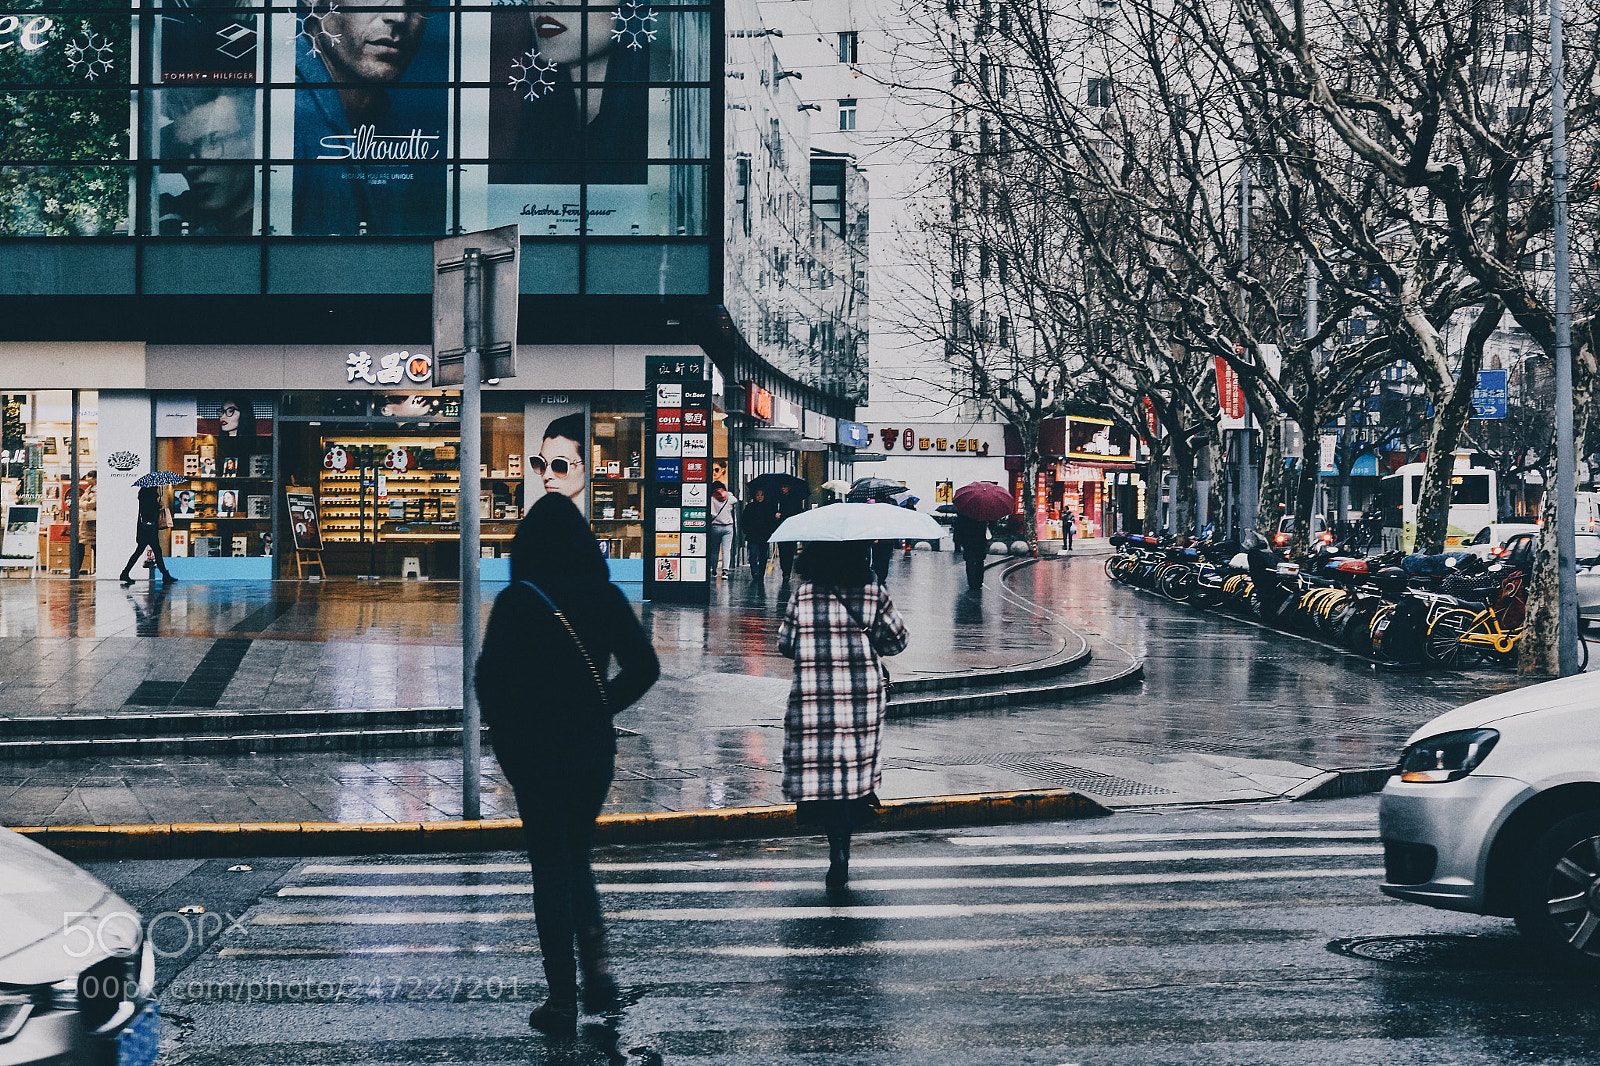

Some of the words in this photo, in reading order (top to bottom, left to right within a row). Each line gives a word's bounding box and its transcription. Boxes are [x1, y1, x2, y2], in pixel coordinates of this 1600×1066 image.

[316, 124, 440, 160] Silhouette
[520, 204, 562, 216] Salvatore
[561, 203, 617, 220] Ferrgamo
[346, 351, 404, 384] 茂昌
[540, 394, 569, 404] FENDI
